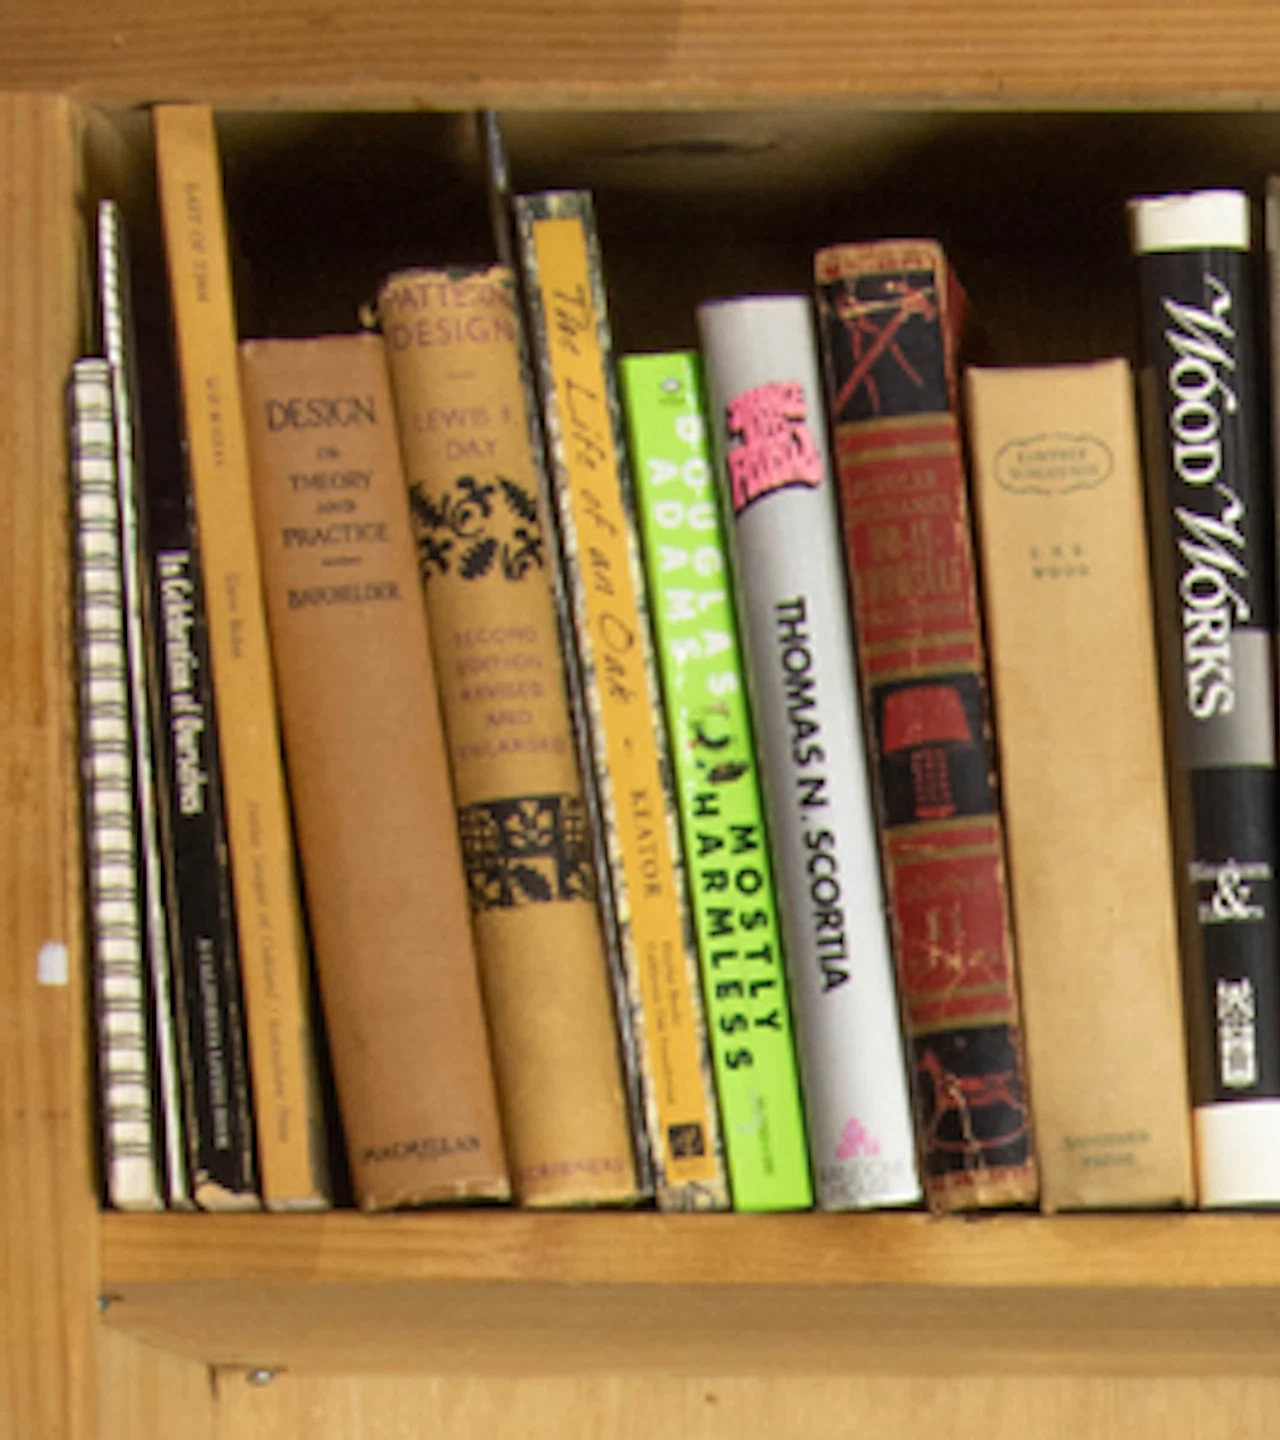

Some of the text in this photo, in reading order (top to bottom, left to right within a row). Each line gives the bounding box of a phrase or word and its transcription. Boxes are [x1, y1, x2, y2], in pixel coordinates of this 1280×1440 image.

[265, 397, 377, 430] DESIGN
[392, 315, 513, 351] DESIGN
[281, 522, 390, 547] PRACTICE
[289, 471, 371, 492] THEORY
[553, 284, 637, 702] The Life of an Oak
[674, 417, 737, 691] DOUGLAS
[156, 552, 206, 814] In Celebration of Ourselves
[631, 789, 664, 899] KEATOR
[778, 596, 850, 990] THOMAS N. SCORTIA
[693, 794, 753, 1073] HARMLESS
[730, 823, 782, 1033] MOSTLY
